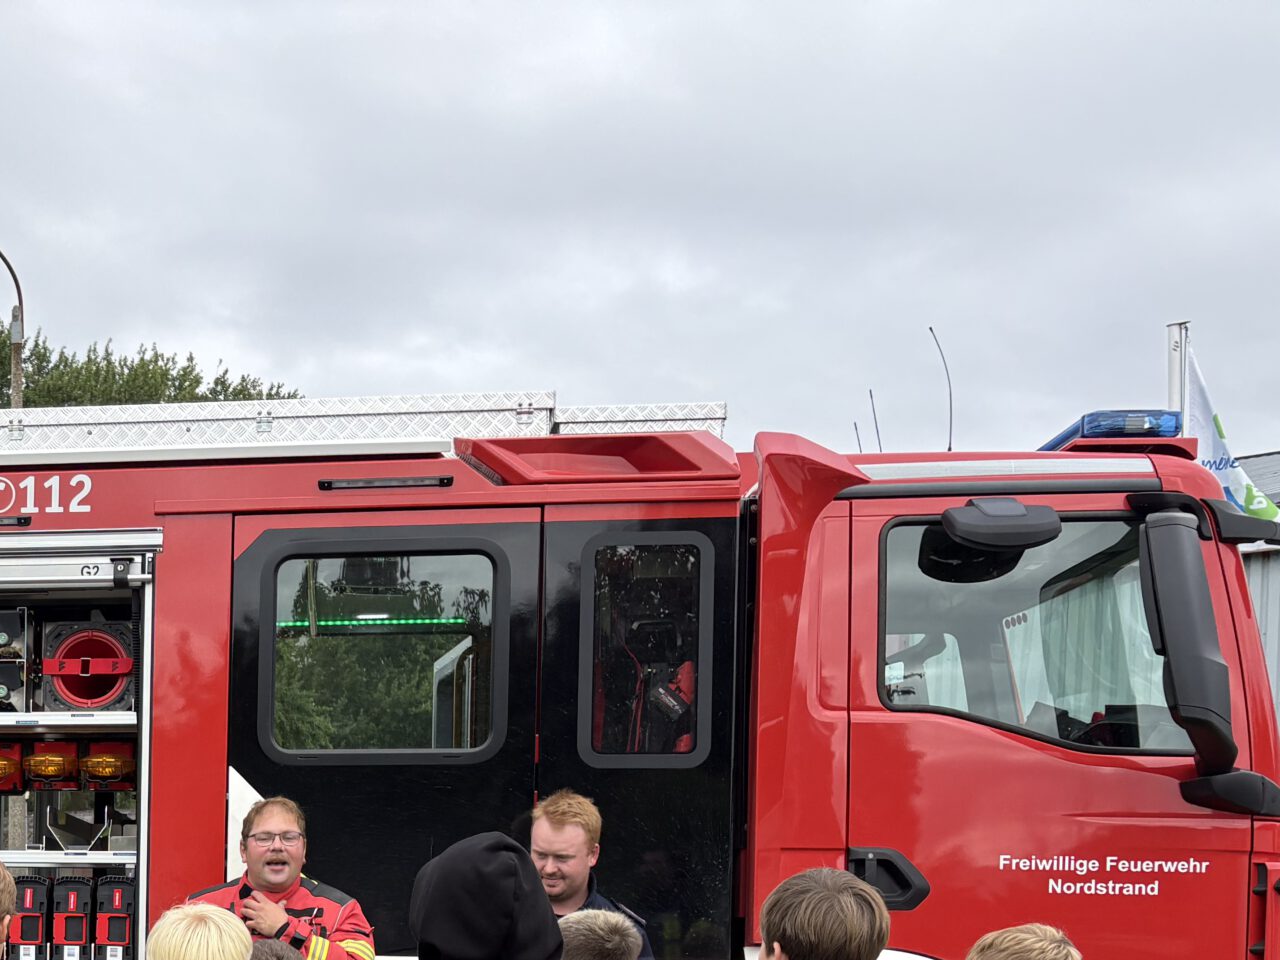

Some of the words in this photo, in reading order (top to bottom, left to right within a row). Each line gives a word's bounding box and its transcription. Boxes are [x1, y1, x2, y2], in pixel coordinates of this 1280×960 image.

[18, 474, 92, 514] 112
[999, 855, 1099, 875] Freiwillige
[1106, 856, 1210, 873] Feuerwehr
[1048, 878, 1159, 895] Nordstrand
